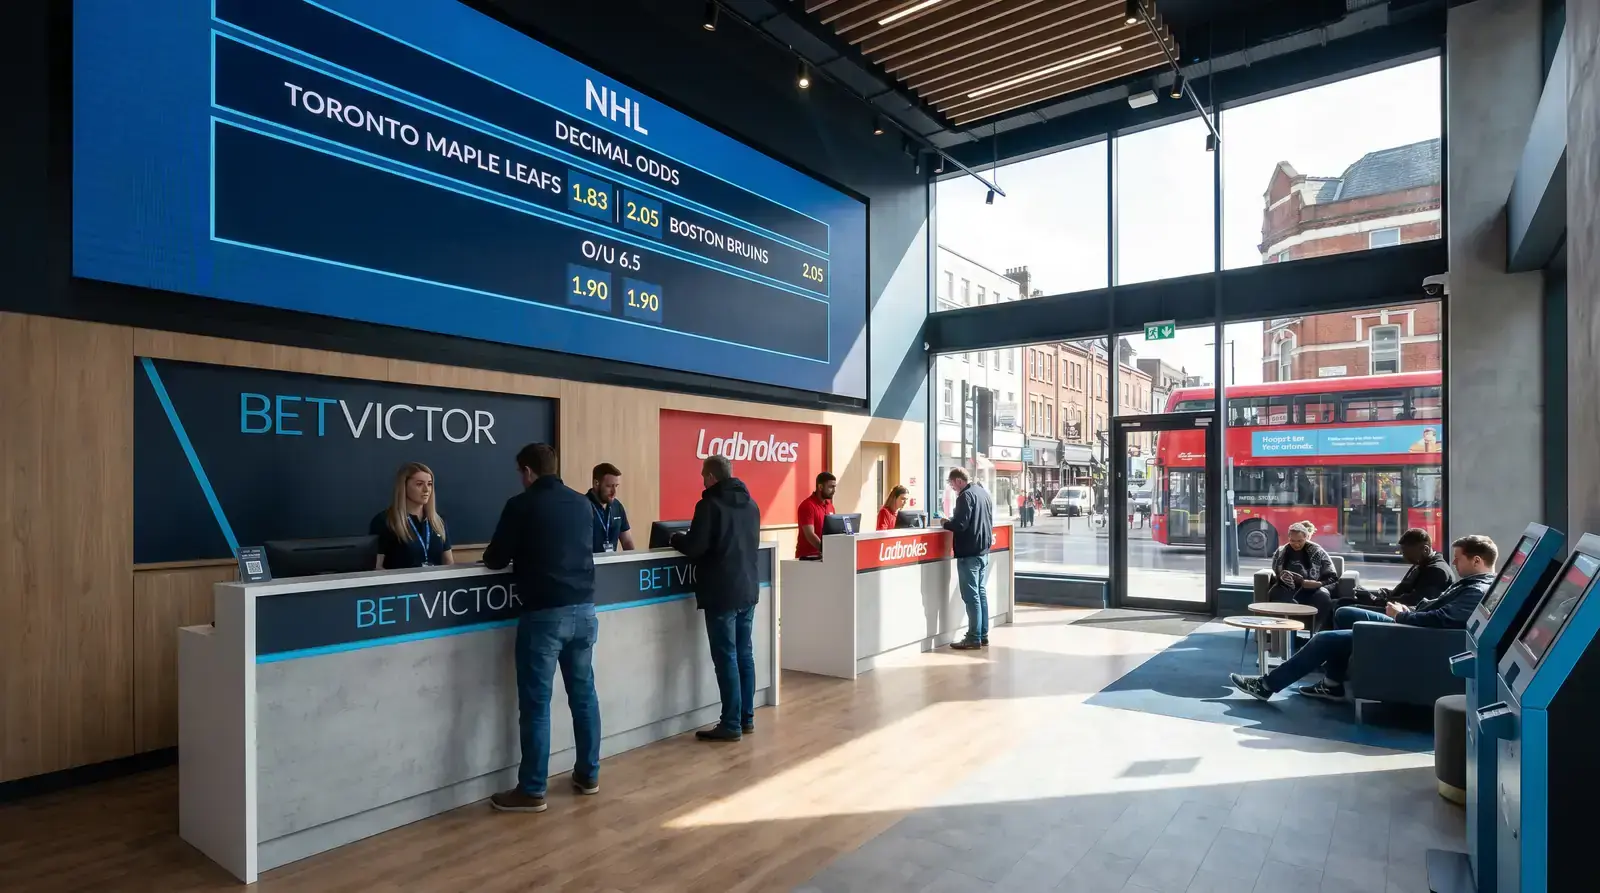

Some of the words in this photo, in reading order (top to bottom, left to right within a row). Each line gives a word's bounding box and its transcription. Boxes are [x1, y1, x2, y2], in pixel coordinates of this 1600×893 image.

[585, 78, 648, 135] NHL
[284, 82, 419, 145] TORONTO
[426, 132, 499, 174] MAPLE
[505, 159, 562, 194] LEAFS
[555, 120, 632, 167] DECIMAL
[635, 155, 680, 185] ODDS
[572, 183, 608, 210] 1.83
[626, 202, 659, 227] 2.05
[669, 217, 724, 249] BOSTON
[727, 238, 769, 264] BRUINS
[802, 263, 824, 282] 2.05
[581, 240, 615, 263] O/U
[619, 252, 641, 270] 6.5
[572, 276, 608, 299] 1.90
[627, 289, 659, 311] 1.90
[240, 392, 496, 445] BETVICTOR
[696, 428, 799, 462] Ladbrokes
[879, 540, 928, 561] Ladbrokes
[356, 583, 523, 628] BETVICTOR
